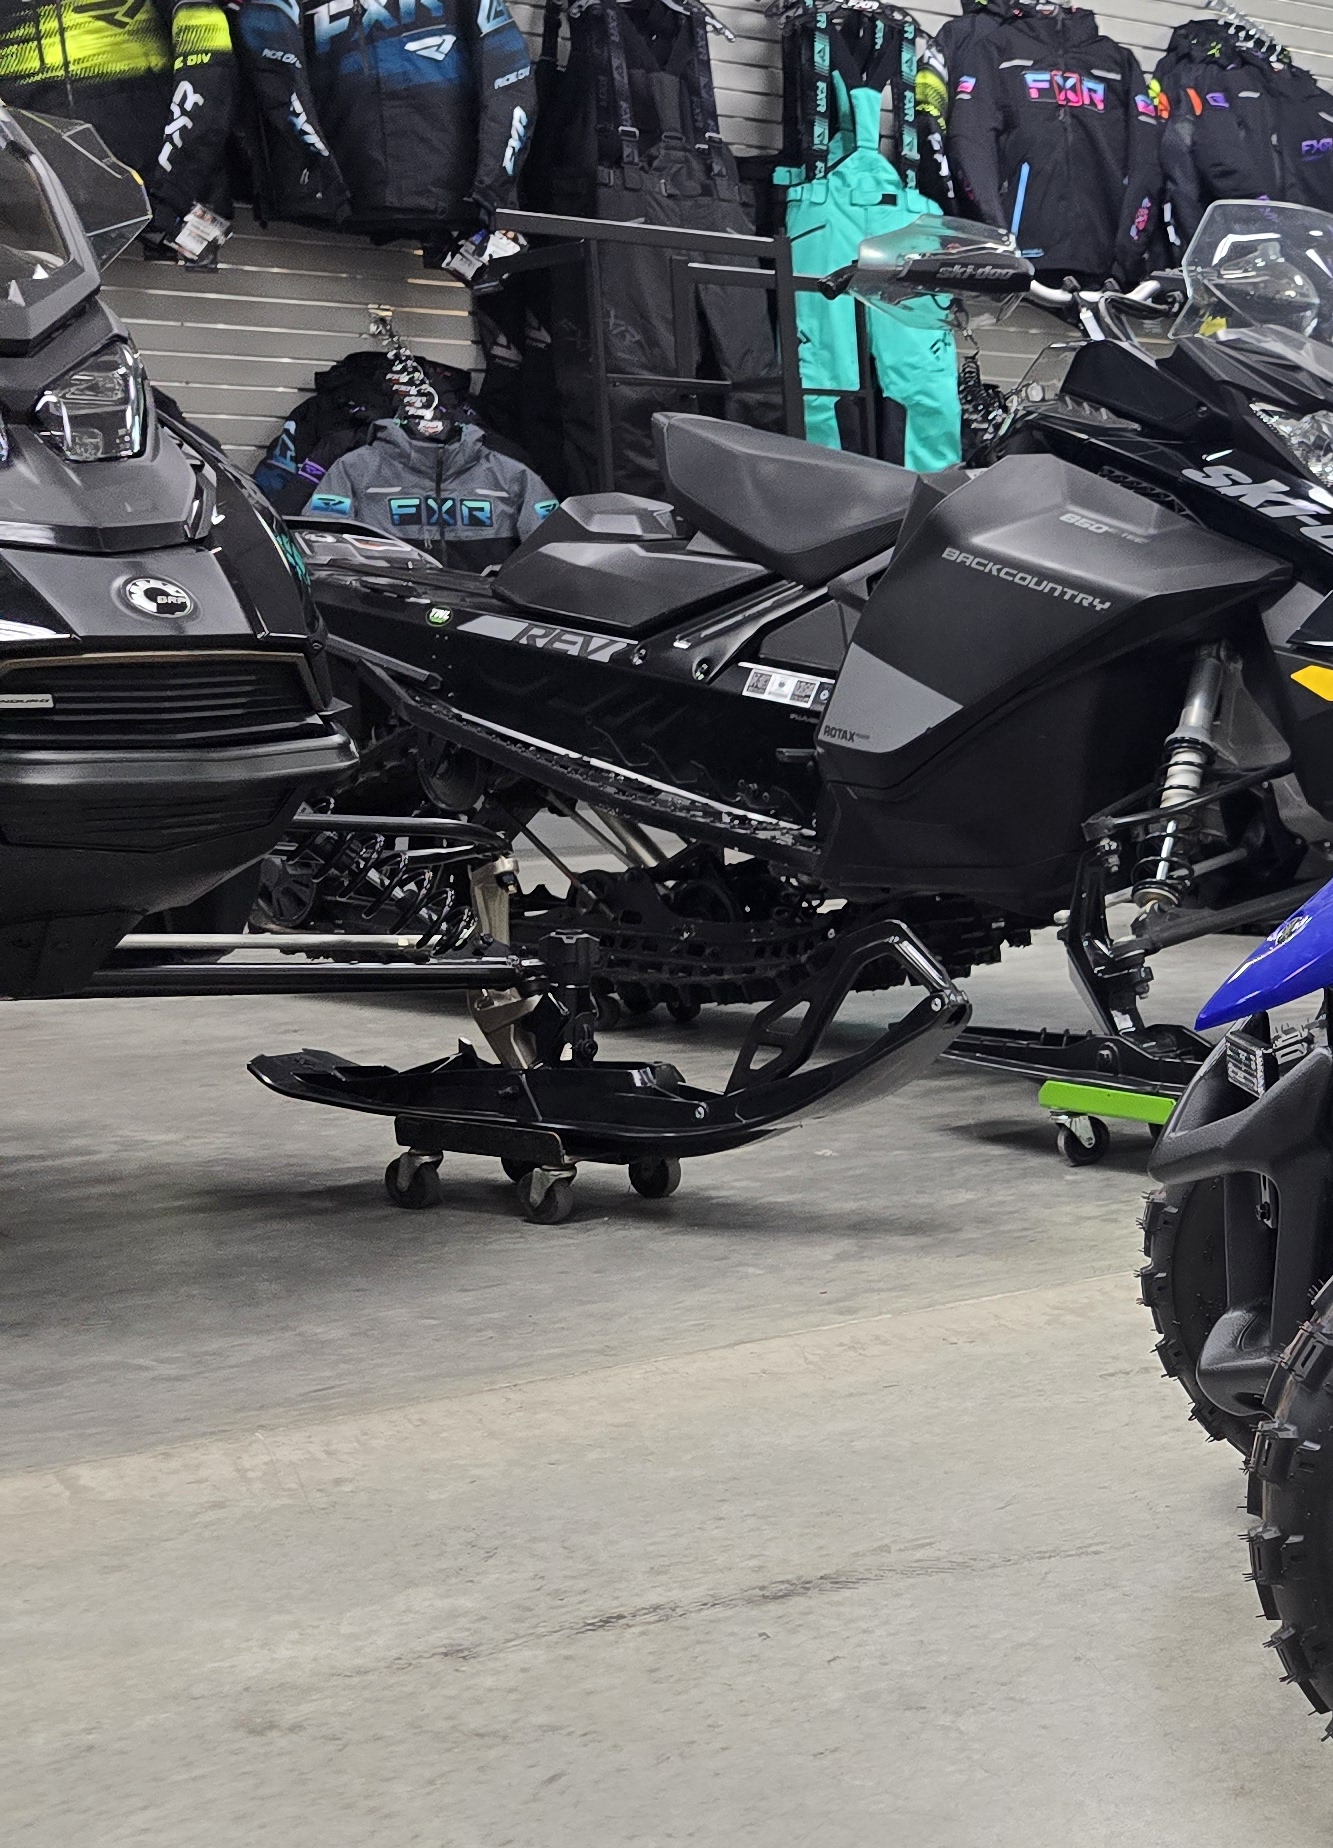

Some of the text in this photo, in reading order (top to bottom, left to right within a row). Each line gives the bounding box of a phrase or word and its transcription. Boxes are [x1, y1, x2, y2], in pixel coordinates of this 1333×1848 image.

[186, 52, 212, 67] DIV
[1021, 69, 1107, 113] FXR
[158, 80, 204, 172] FXR
[288, 91, 330, 157] FXR
[502, 105, 518, 177] FXR
[1302, 137, 1333, 152] FXR
[936, 264, 1015, 280] ski-doo
[388, 497, 492, 526] FXR
[941, 546, 1112, 611] BACKCOUNTRY
[511, 623, 620, 659] REV
[823, 724, 856, 743] ROTAX
